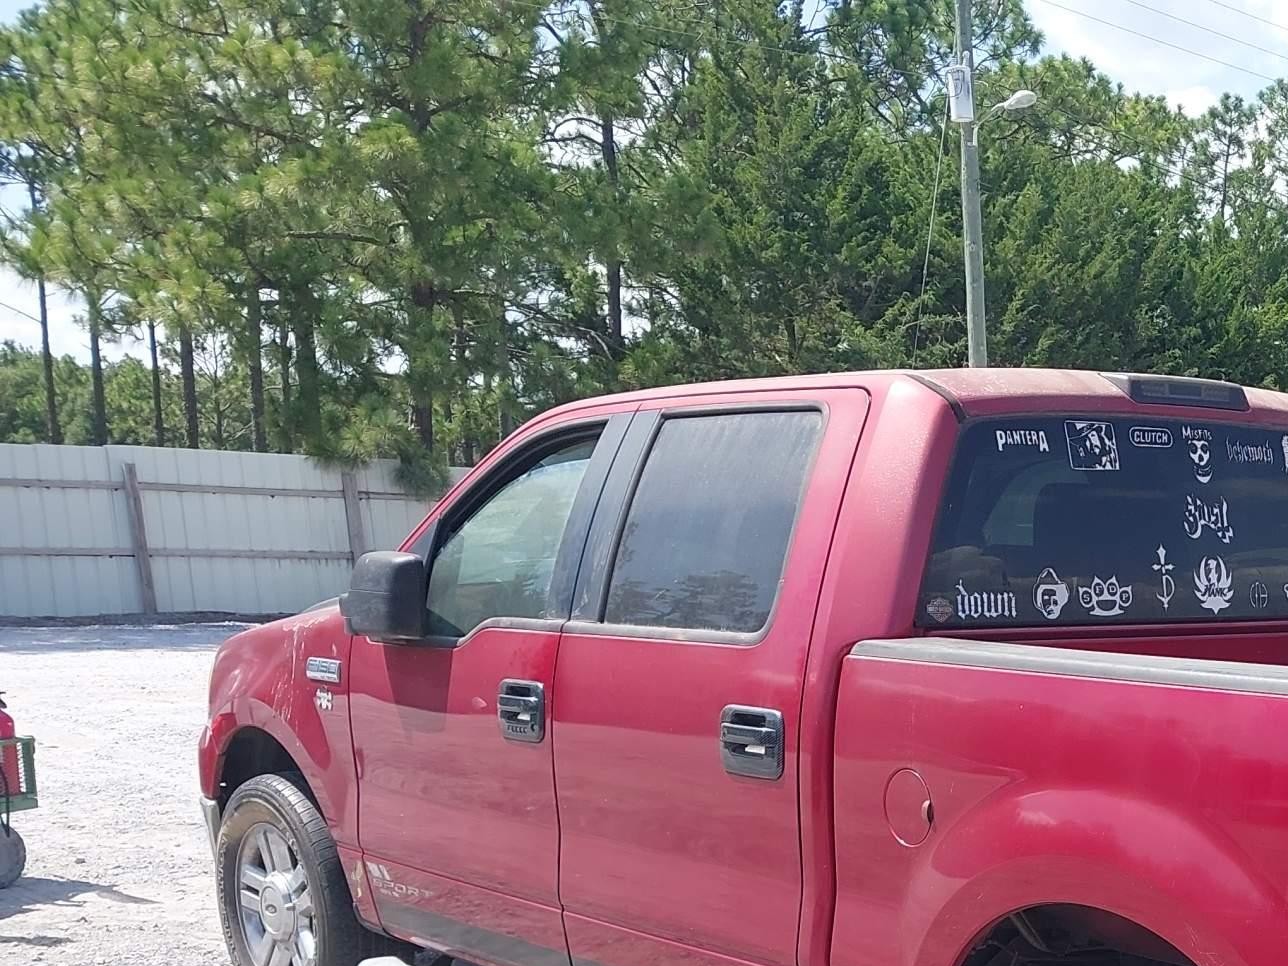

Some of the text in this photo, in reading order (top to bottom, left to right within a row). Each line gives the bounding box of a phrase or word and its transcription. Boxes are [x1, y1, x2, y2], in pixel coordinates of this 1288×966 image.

[995, 430, 1050, 452] PANTERA
[1134, 430, 1169, 445] CLUTCH
[372, 877, 434, 897] SPORT
